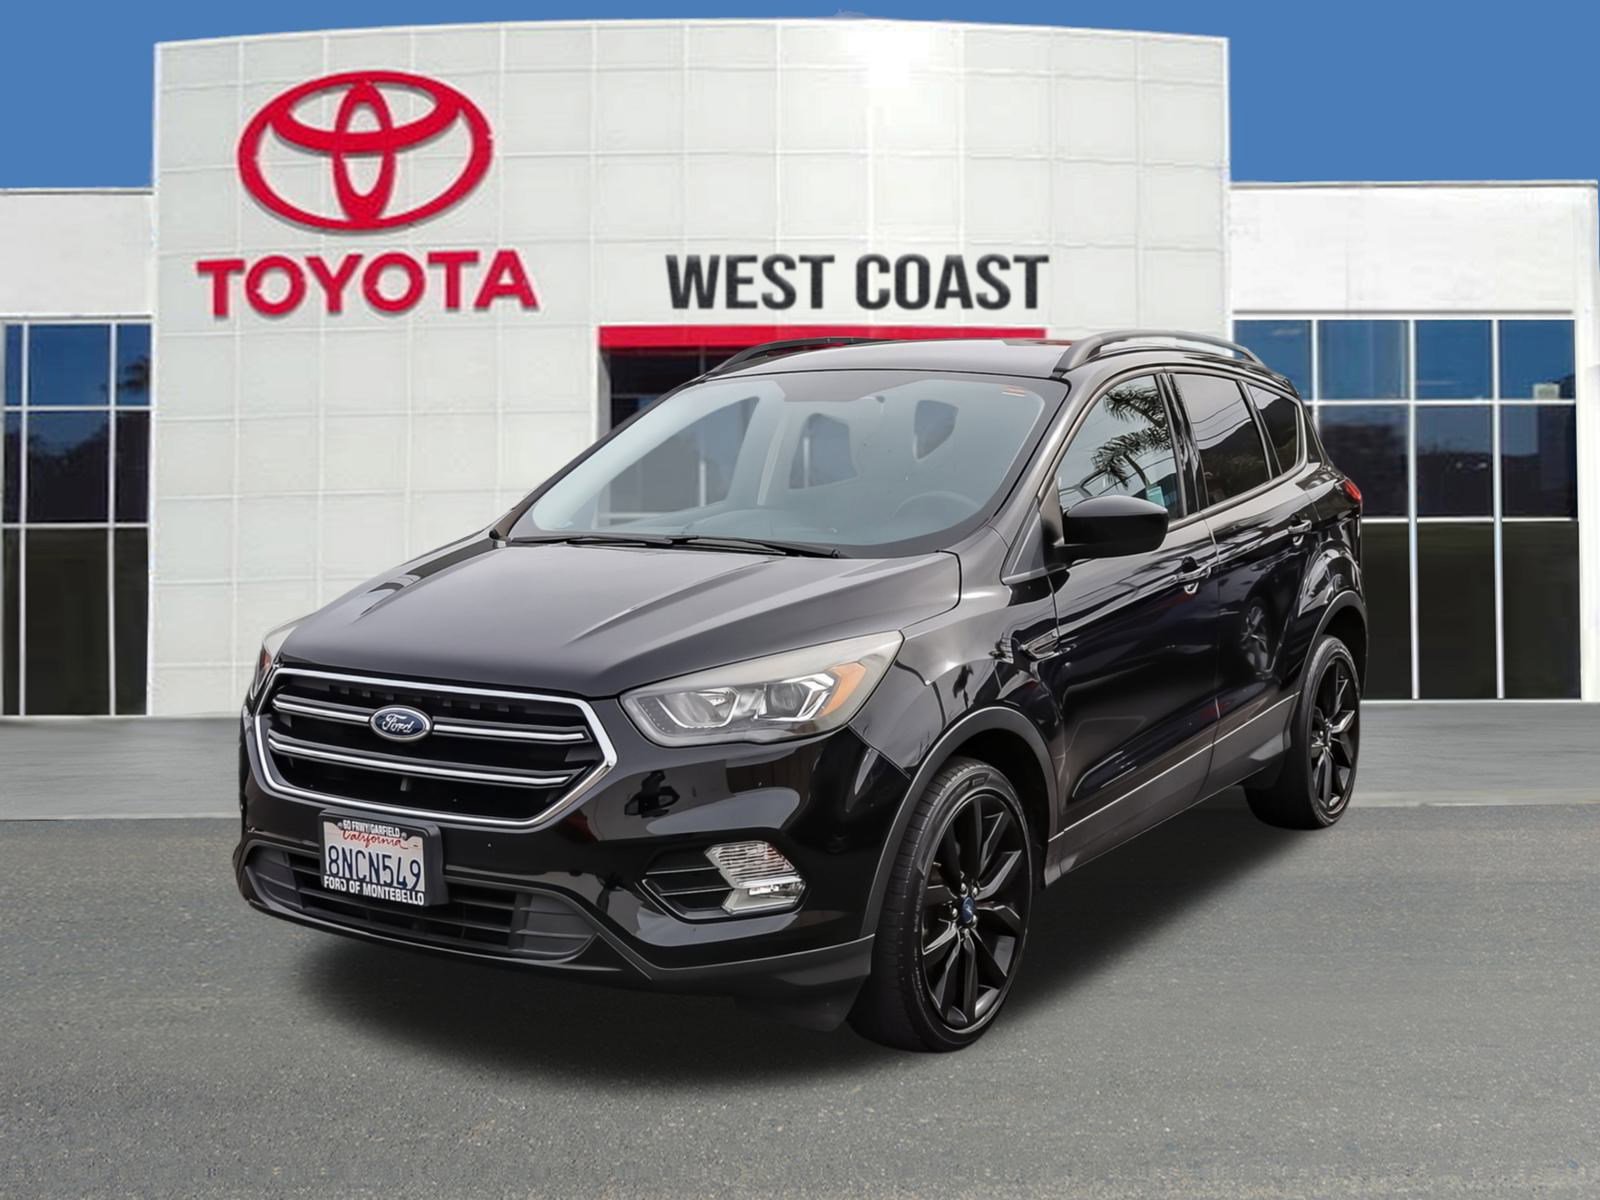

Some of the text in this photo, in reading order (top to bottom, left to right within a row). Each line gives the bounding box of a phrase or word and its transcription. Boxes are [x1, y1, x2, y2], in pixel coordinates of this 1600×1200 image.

[196, 250, 539, 318] TOYOTA
[666, 254, 1049, 310] WEST COAST
[382, 713, 415, 733] Ford
[342, 829, 409, 849] California
[328, 844, 421, 892] 8NCN549
[324, 875, 425, 907] FORD OF MONTEBELLO
